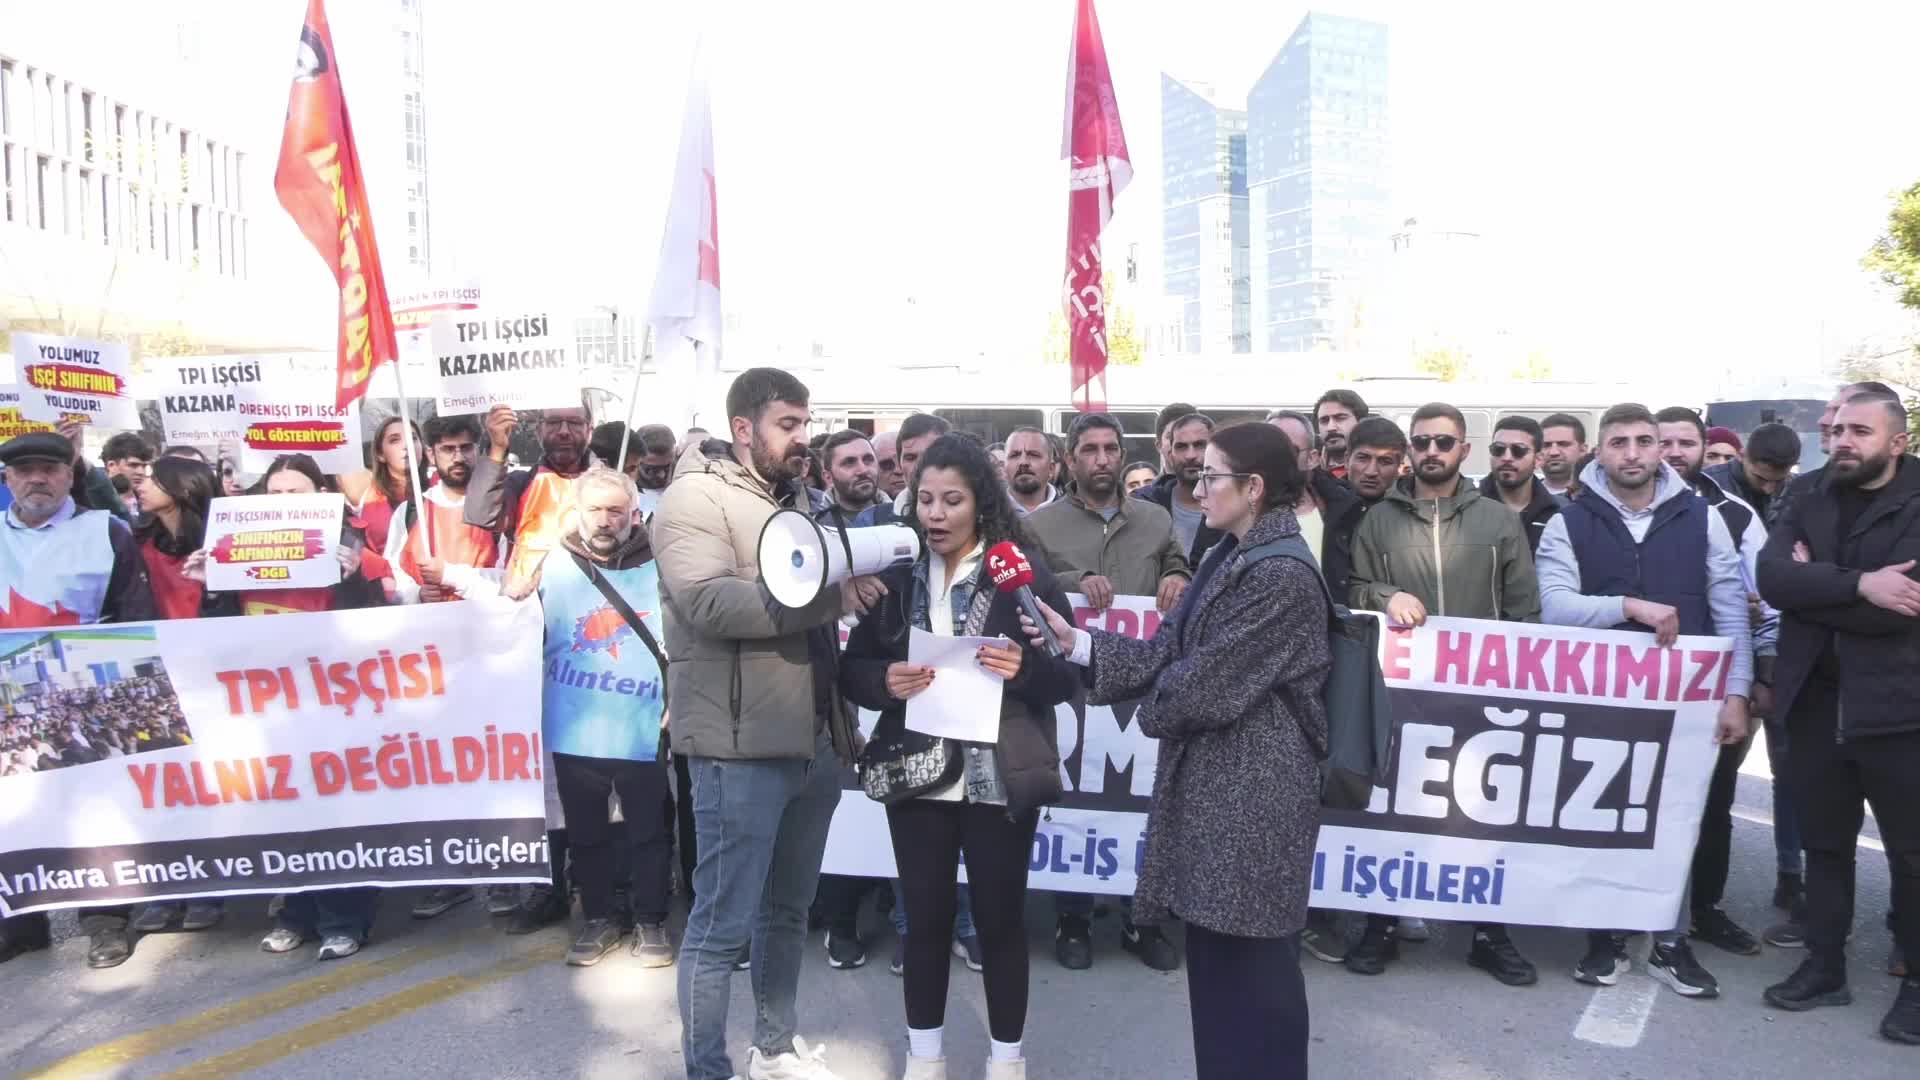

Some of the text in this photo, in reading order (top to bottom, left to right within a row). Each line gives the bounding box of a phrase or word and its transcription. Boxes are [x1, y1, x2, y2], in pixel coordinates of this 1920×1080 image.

[456, 313, 549, 344] TPI İŞÇİSİ
[39, 345, 101, 365] YOLUMUZ
[439, 348, 566, 378] KAZANACAK!
[60, 370, 117, 393] SINIFININ
[178, 361, 262, 388] TPI İŞÇİSİ
[44, 393, 102, 412] YOLUDUR!
[165, 394, 237, 413] KAZANA
[247, 427, 344, 442] YOL GÖSTERİYOR!
[287, 508, 336, 520] YANINDA
[259, 566, 289, 578] DGB
[1434, 629, 1734, 702] HAKKIMIZI
[216, 644, 446, 716] TPI İŞÇİSİ
[128, 724, 542, 809] YALNIZ DEĞİLDİR!
[1367, 706, 1661, 834] EĞİZ!
[0, 835, 549, 897] Ankara Emek ve Demokrasi Güçleri
[1029, 828, 1119, 881] OL-İŞ
[1341, 845, 1506, 906] İŞÇİLERİ
